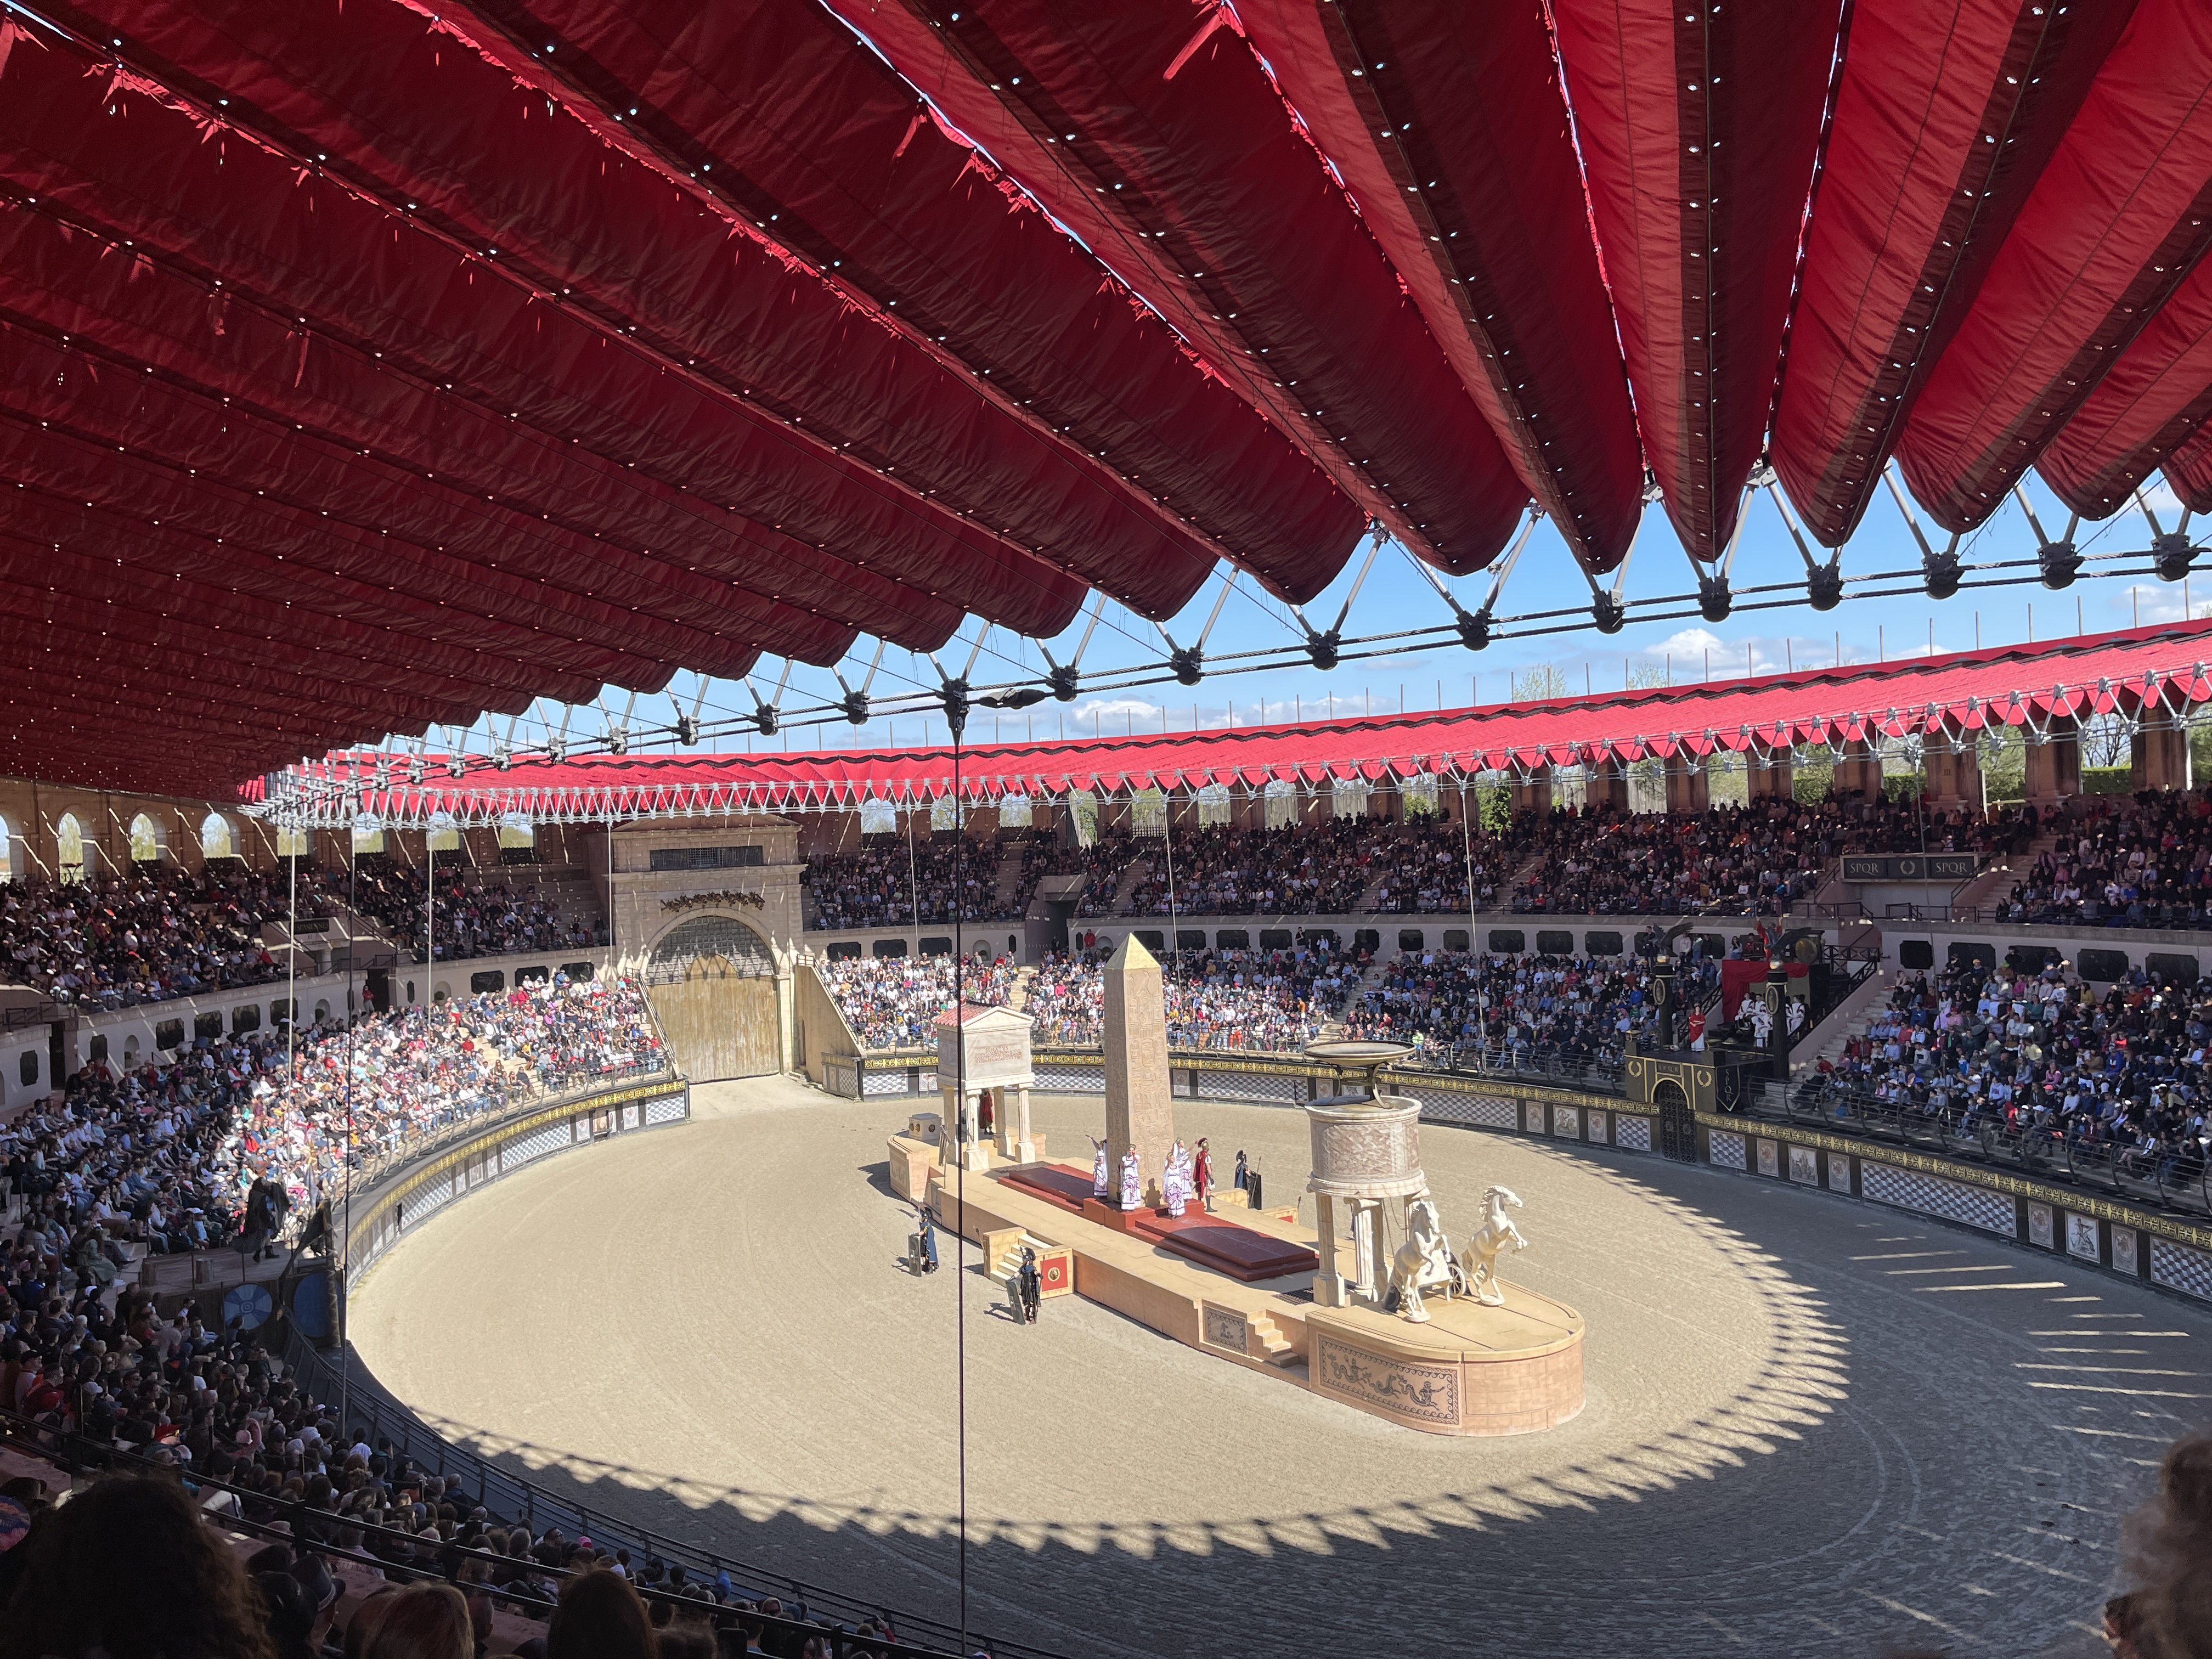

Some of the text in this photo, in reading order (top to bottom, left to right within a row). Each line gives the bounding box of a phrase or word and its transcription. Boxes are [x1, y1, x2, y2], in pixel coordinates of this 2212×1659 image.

[1850, 862, 1967, 876] SPQR SPQR
[1724, 1069, 1734, 1102] SPQR
